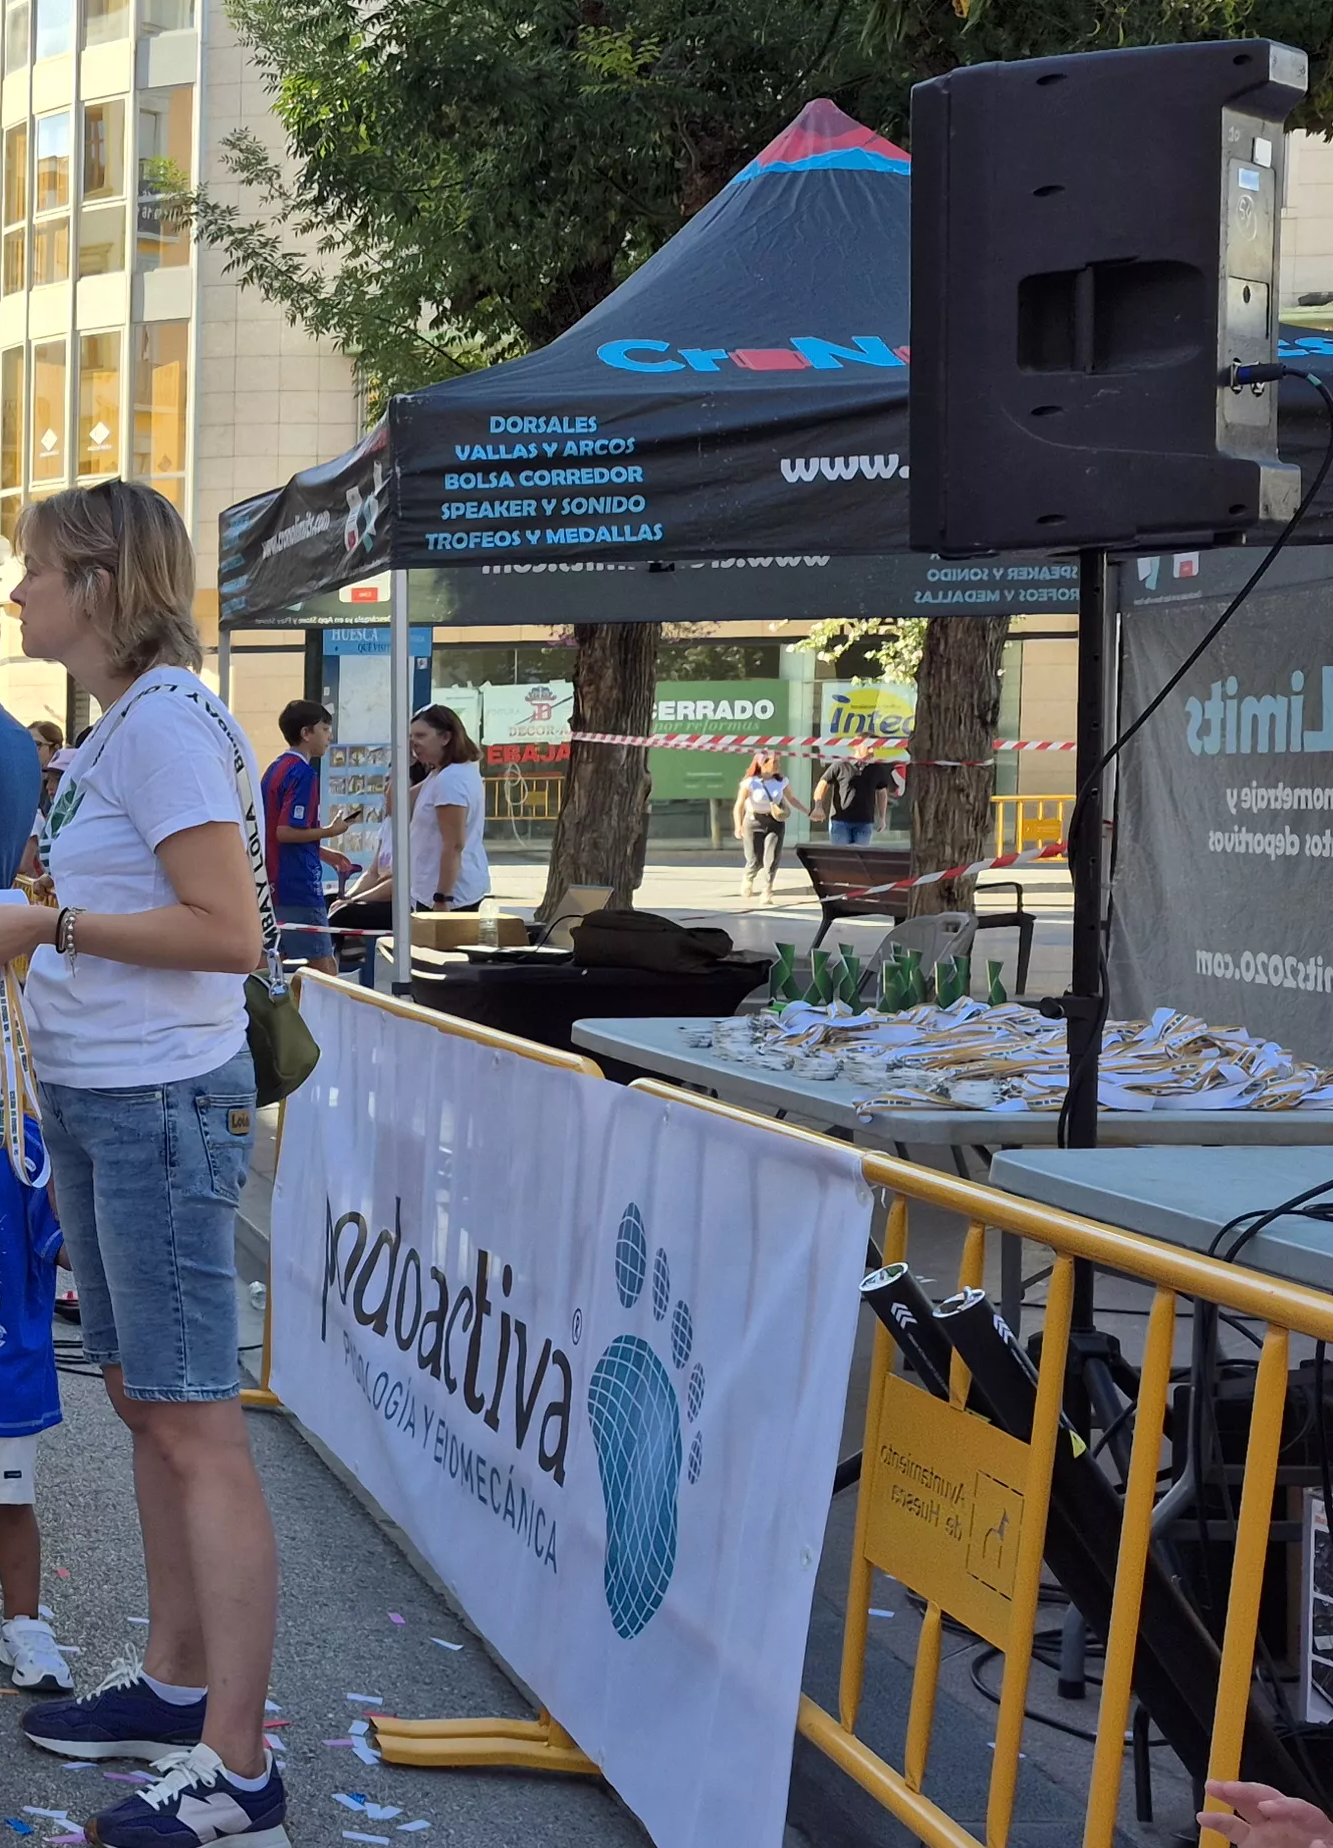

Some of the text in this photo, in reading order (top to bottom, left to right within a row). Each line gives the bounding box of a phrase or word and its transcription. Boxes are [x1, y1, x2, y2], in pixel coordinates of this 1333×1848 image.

[489, 415, 598, 434] DORSALES
[454, 437, 636, 461] VALLAS Y ARCOS
[444, 465, 644, 490] BOLSA CORREDOR
[440, 494, 646, 521] SPEAKER Y SONIDO
[425, 523, 664, 551] TROFEOS Y MEDALLAS
[331, 628, 378, 641] HUESCA
[680, 719, 760, 735] reformas
[246, 804, 264, 873] LOLA
[424, 1404, 434, 1449] Y
